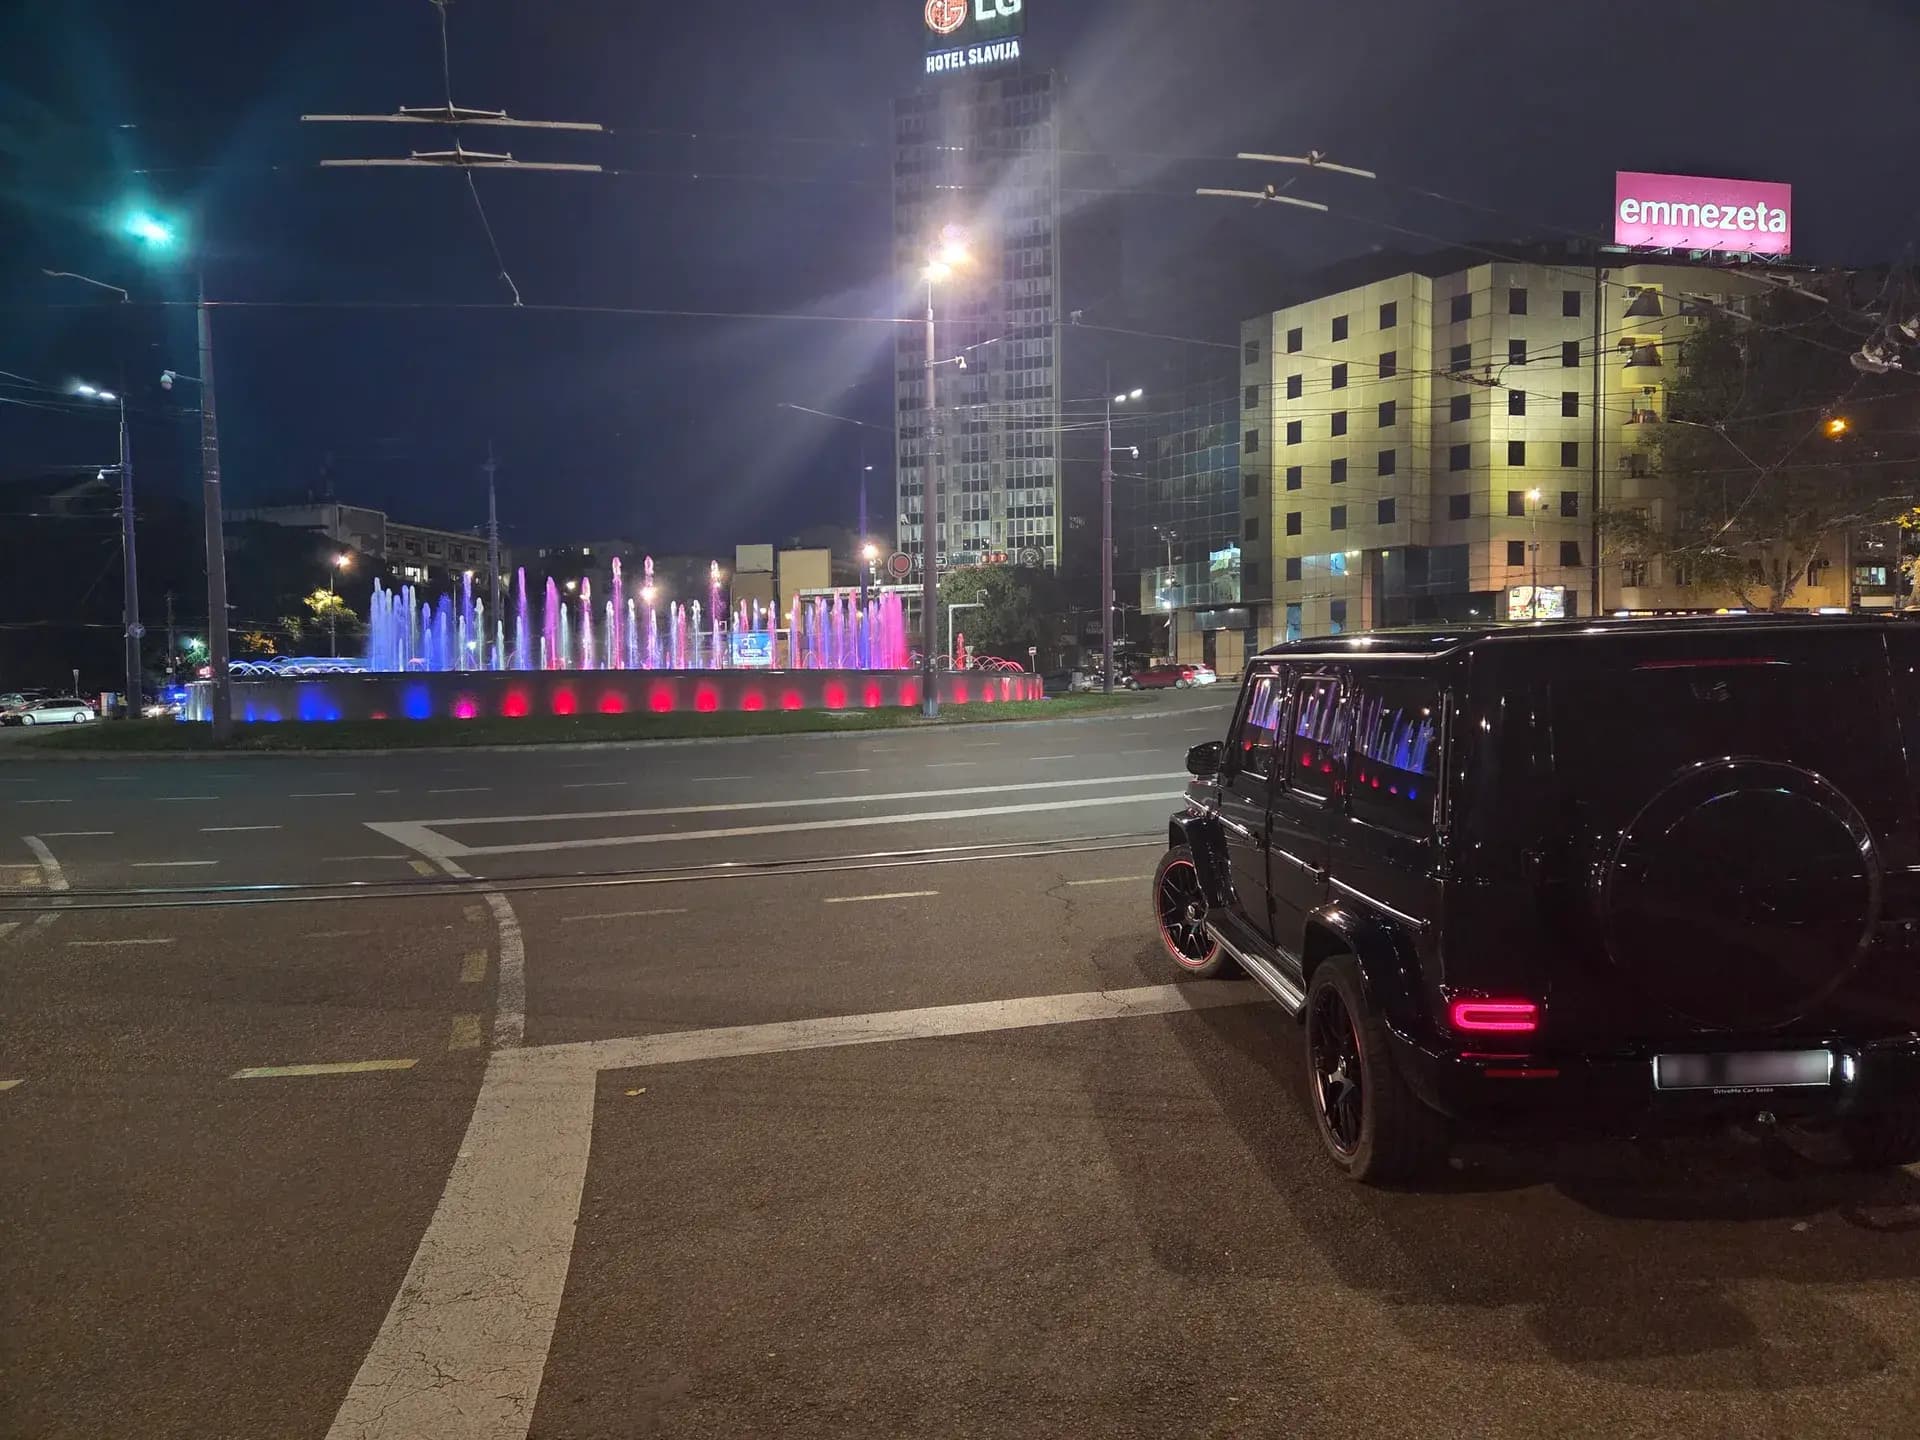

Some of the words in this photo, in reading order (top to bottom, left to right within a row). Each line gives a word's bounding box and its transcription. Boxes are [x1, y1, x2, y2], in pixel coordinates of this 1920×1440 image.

[974, 0, 1022, 20] LG
[926, 50, 966, 73] HOTEL
[968, 41, 1020, 65] SLAVIJA
[1619, 198, 1787, 233] emmezeta
